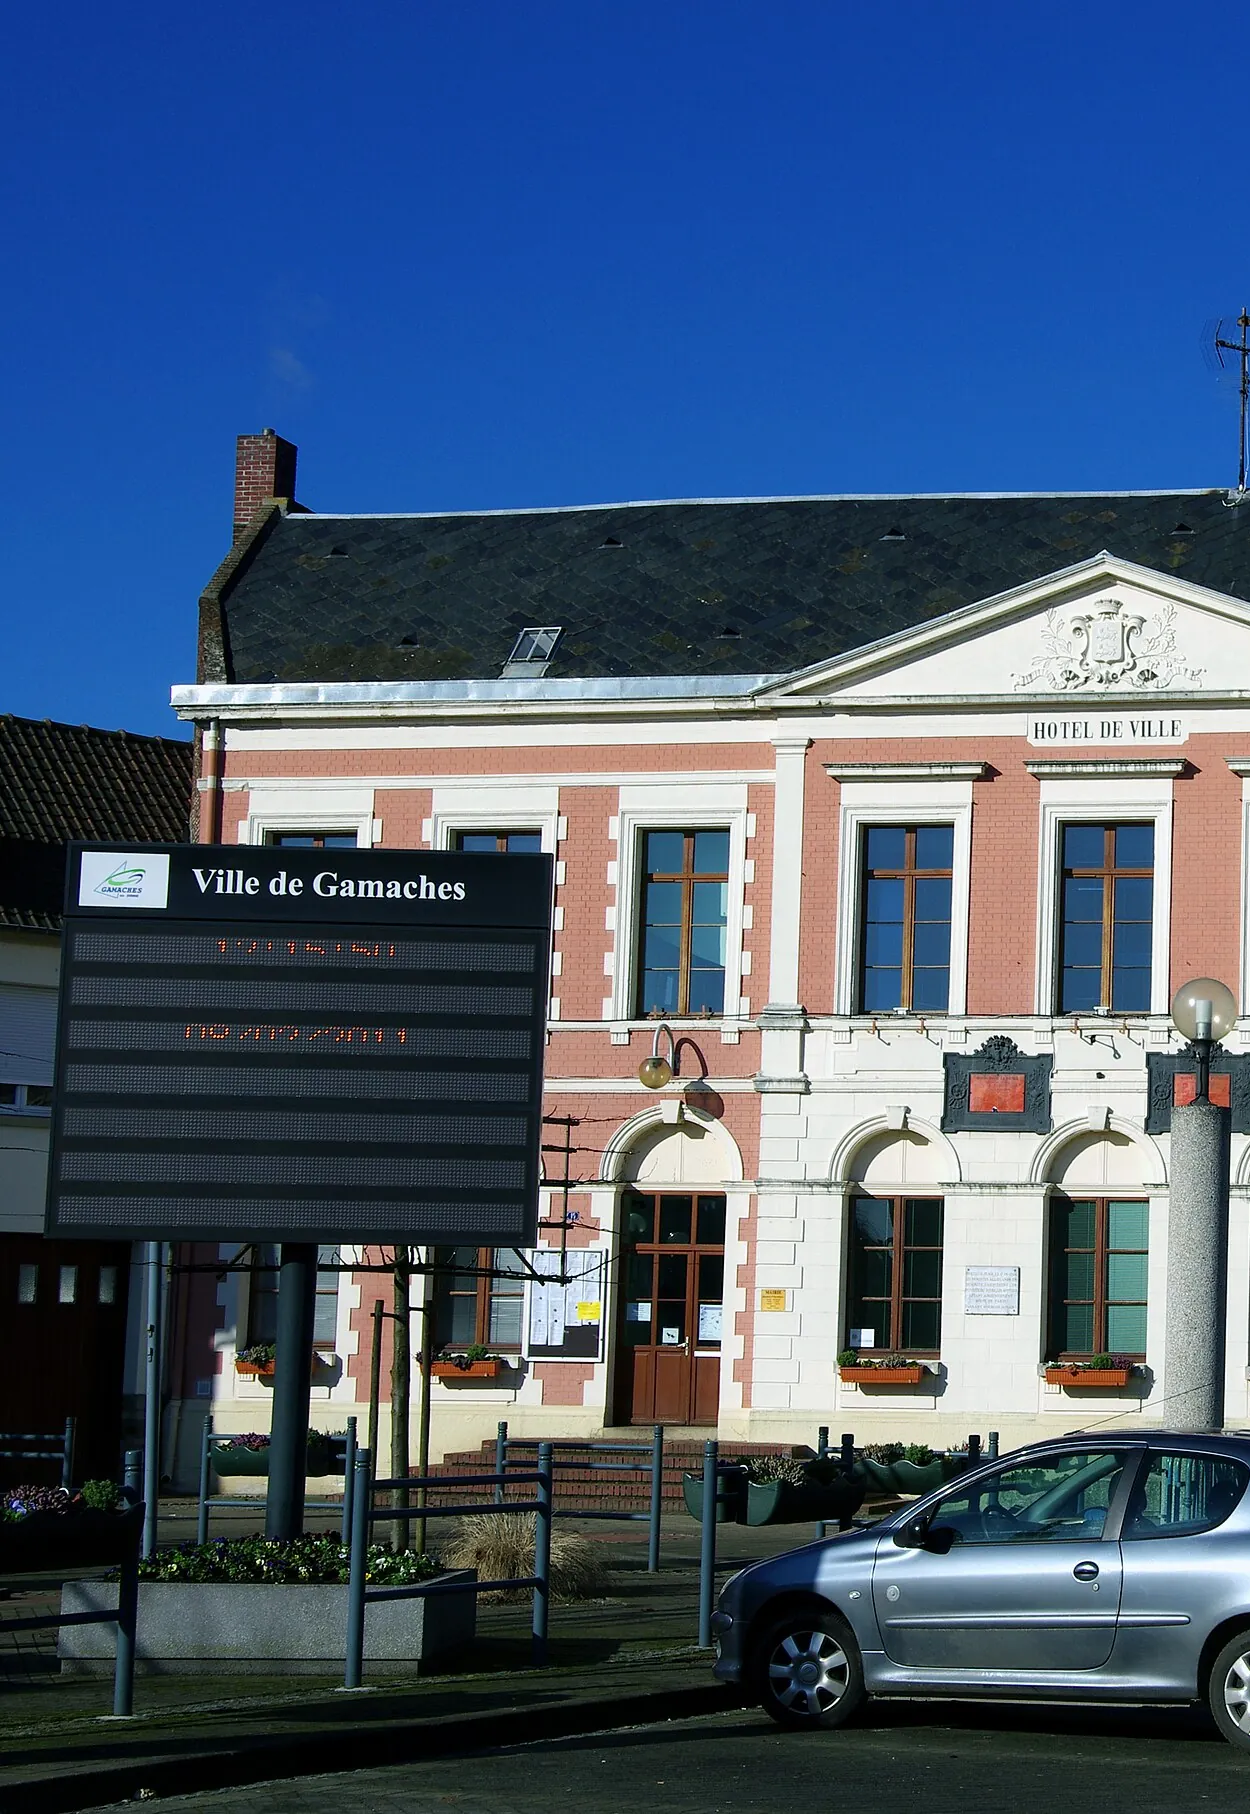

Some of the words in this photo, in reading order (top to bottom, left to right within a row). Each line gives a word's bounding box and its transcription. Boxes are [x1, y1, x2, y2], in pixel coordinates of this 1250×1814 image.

[1033, 721, 1093, 740] HOTEL
[1100, 720, 1123, 739] DE
[1129, 719, 1182, 738] VILLE
[101, 886, 143, 894] GAMACHES
[191, 868, 260, 895] Ville
[268, 871, 304, 896] de
[312, 871, 466, 901] Gamaches
